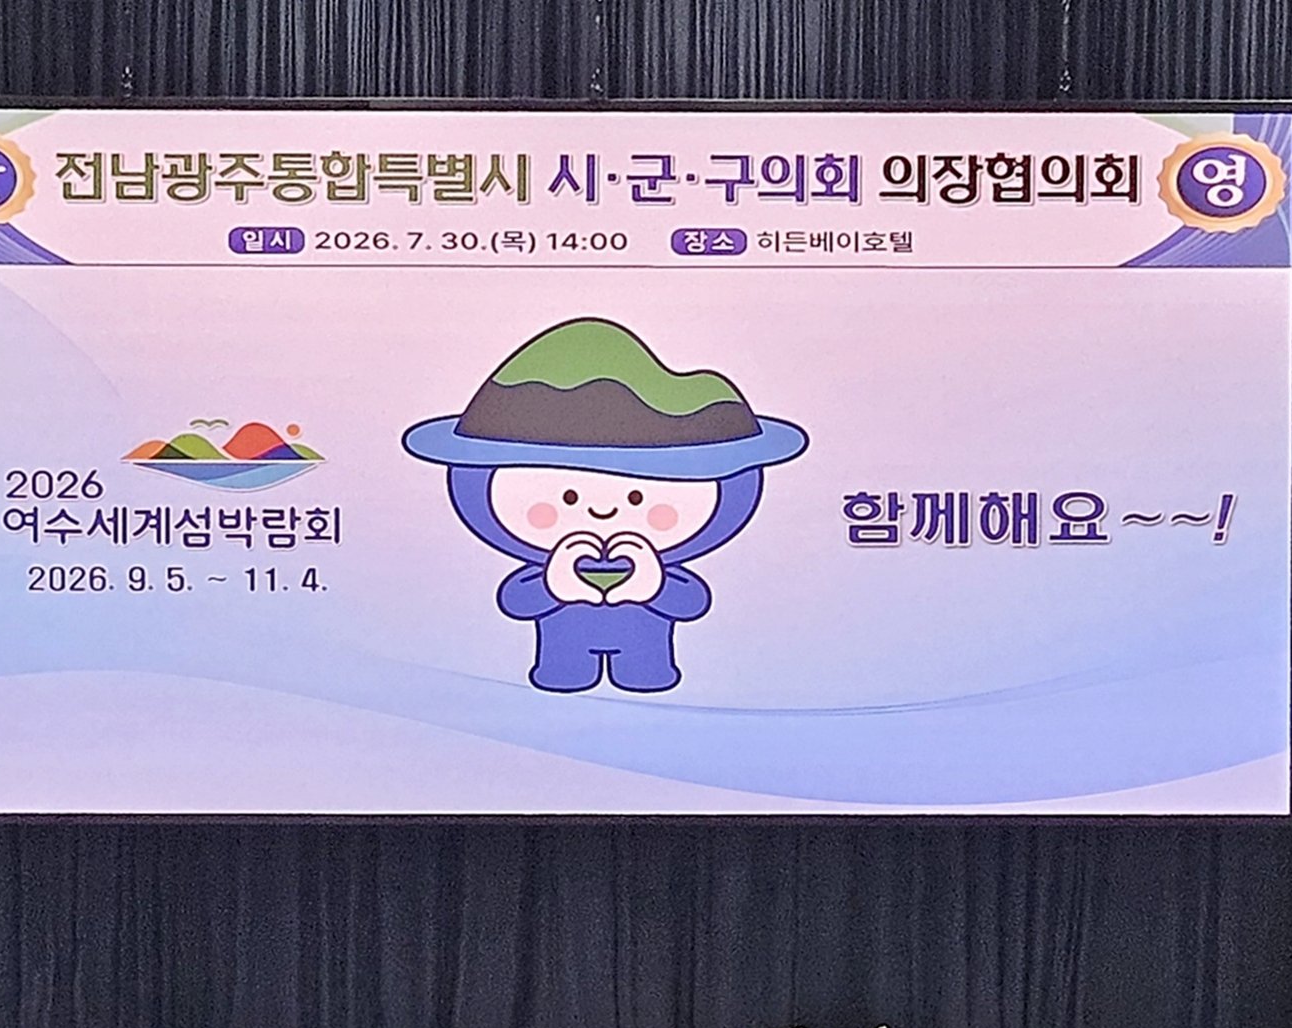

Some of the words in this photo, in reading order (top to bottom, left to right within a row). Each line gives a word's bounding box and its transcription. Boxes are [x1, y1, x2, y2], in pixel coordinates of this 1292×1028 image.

[55, 152, 530, 205] 전남광주통합특별시
[547, 153, 861, 205] 시·군·구의회
[879, 153, 1141, 205] 의장협의회
[1190, 153, 1249, 207] 영
[242, 228, 294, 253] 일시
[314, 231, 399, 251] 2026.
[406, 231, 433, 251] 7.
[442, 229, 538, 255] 30.(목)
[547, 231, 628, 251] 14:00
[682, 230, 737, 253] 장소
[757, 229, 914, 254] 히든베이호텔
[5, 469, 105, 499] 2026
[2, 506, 342, 549] 여수세계섬박람회
[27, 566, 115, 592] 2026.
[127, 566, 154, 592] 9.
[166, 566, 193, 592] 5.
[244, 566, 289, 592] 11.
[300, 566, 329, 592] 4.
